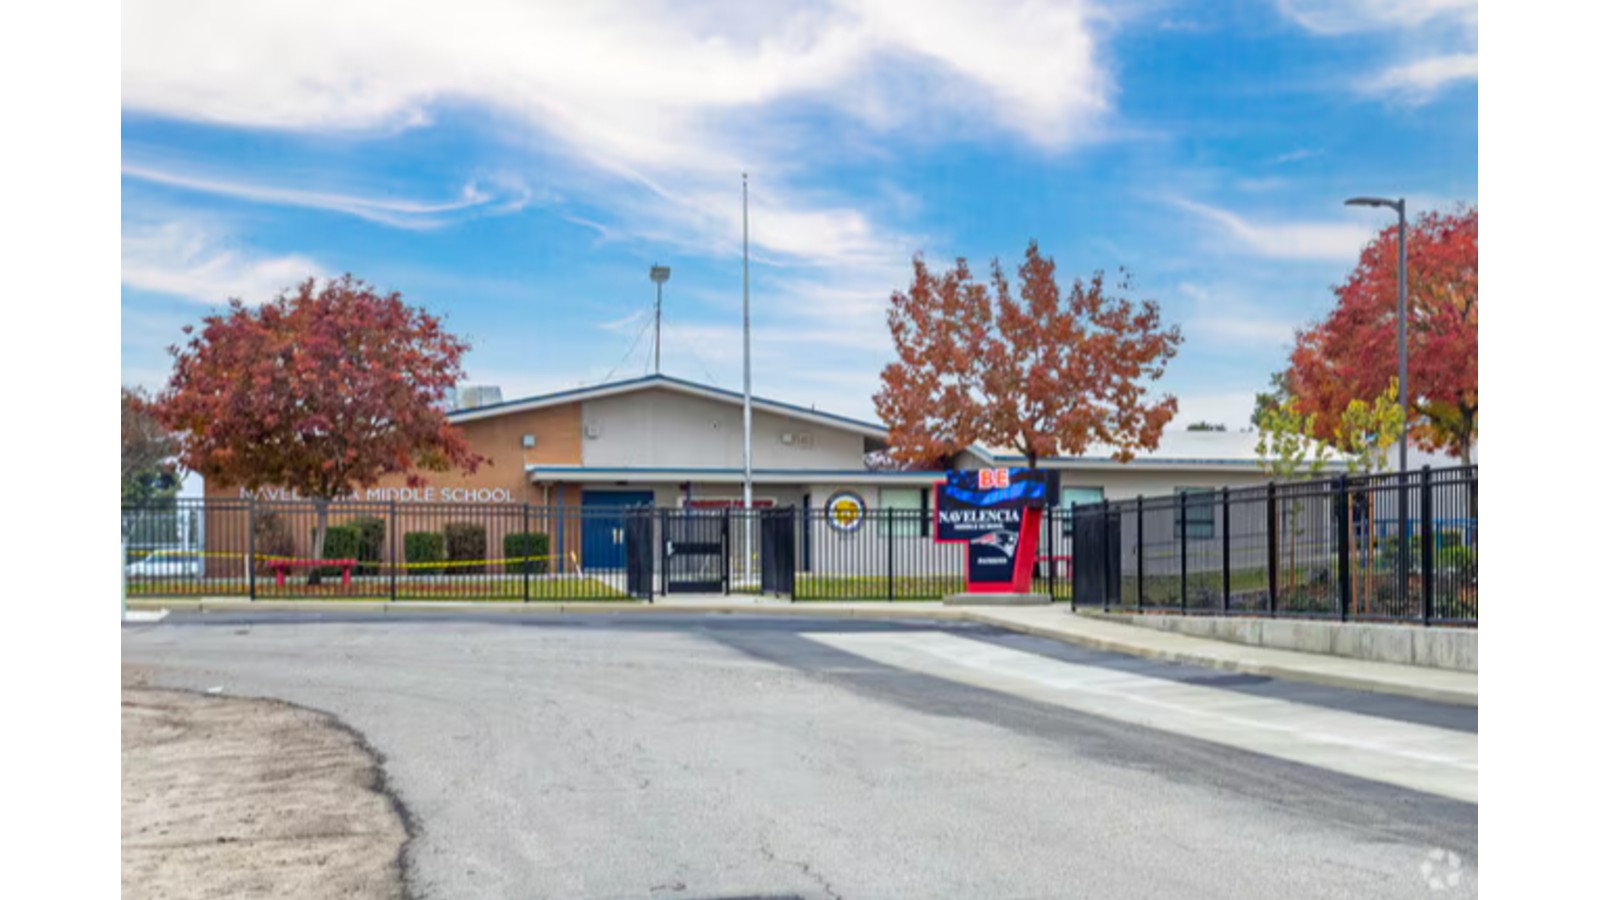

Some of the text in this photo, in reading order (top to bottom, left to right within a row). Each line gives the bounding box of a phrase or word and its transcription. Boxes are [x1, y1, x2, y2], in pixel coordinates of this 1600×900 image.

[979, 468, 1009, 489] BE
[366, 487, 433, 501] MIDDLE
[441, 487, 514, 502] SCHOOL
[939, 509, 1020, 522] NAVELENCIA
